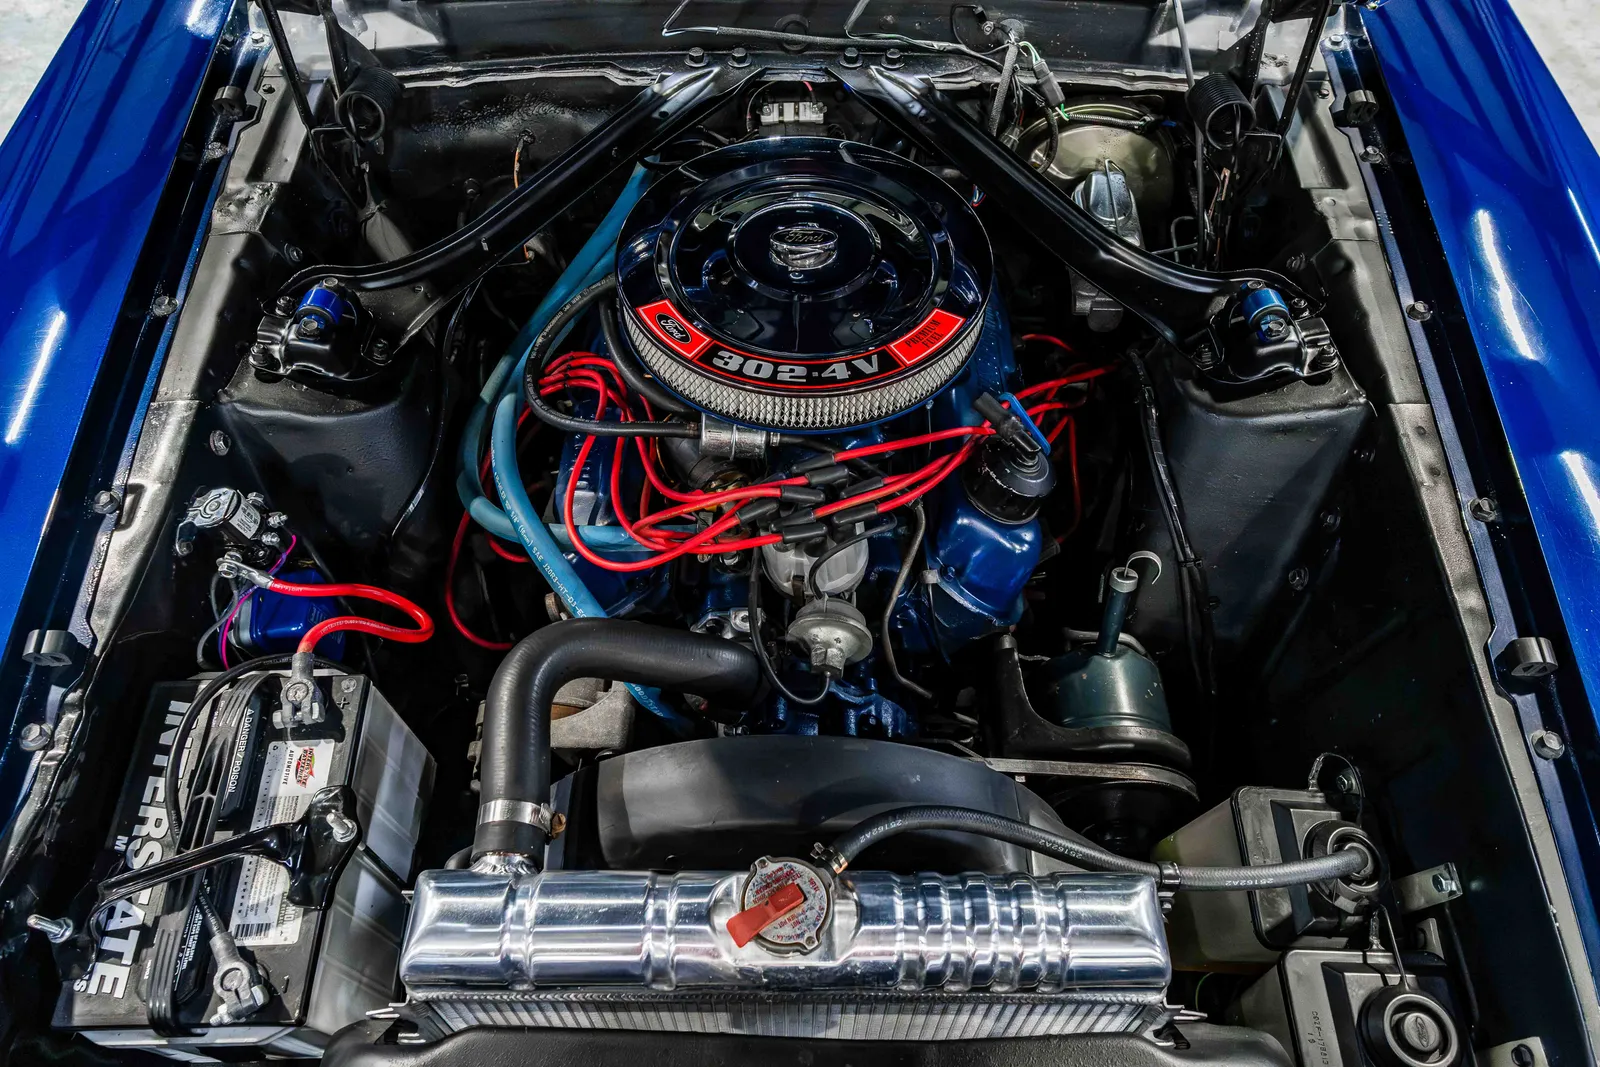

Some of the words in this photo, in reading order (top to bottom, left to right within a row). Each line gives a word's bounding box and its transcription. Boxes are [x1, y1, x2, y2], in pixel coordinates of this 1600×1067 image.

[784, 229, 828, 242] Ford
[660, 319, 686, 339] Ford
[905, 319, 941, 348] PREMIUM
[921, 331, 945, 349] FUEL
[531, 546, 544, 562] SAE
[238, 717, 252, 753] DANGER
[228, 760, 242, 793] POISON
[282, 749, 294, 785] AUTOMOTIVE
[301, 747, 313, 787] INTERSTATE
[87, 701, 199, 999] INTERSATE
